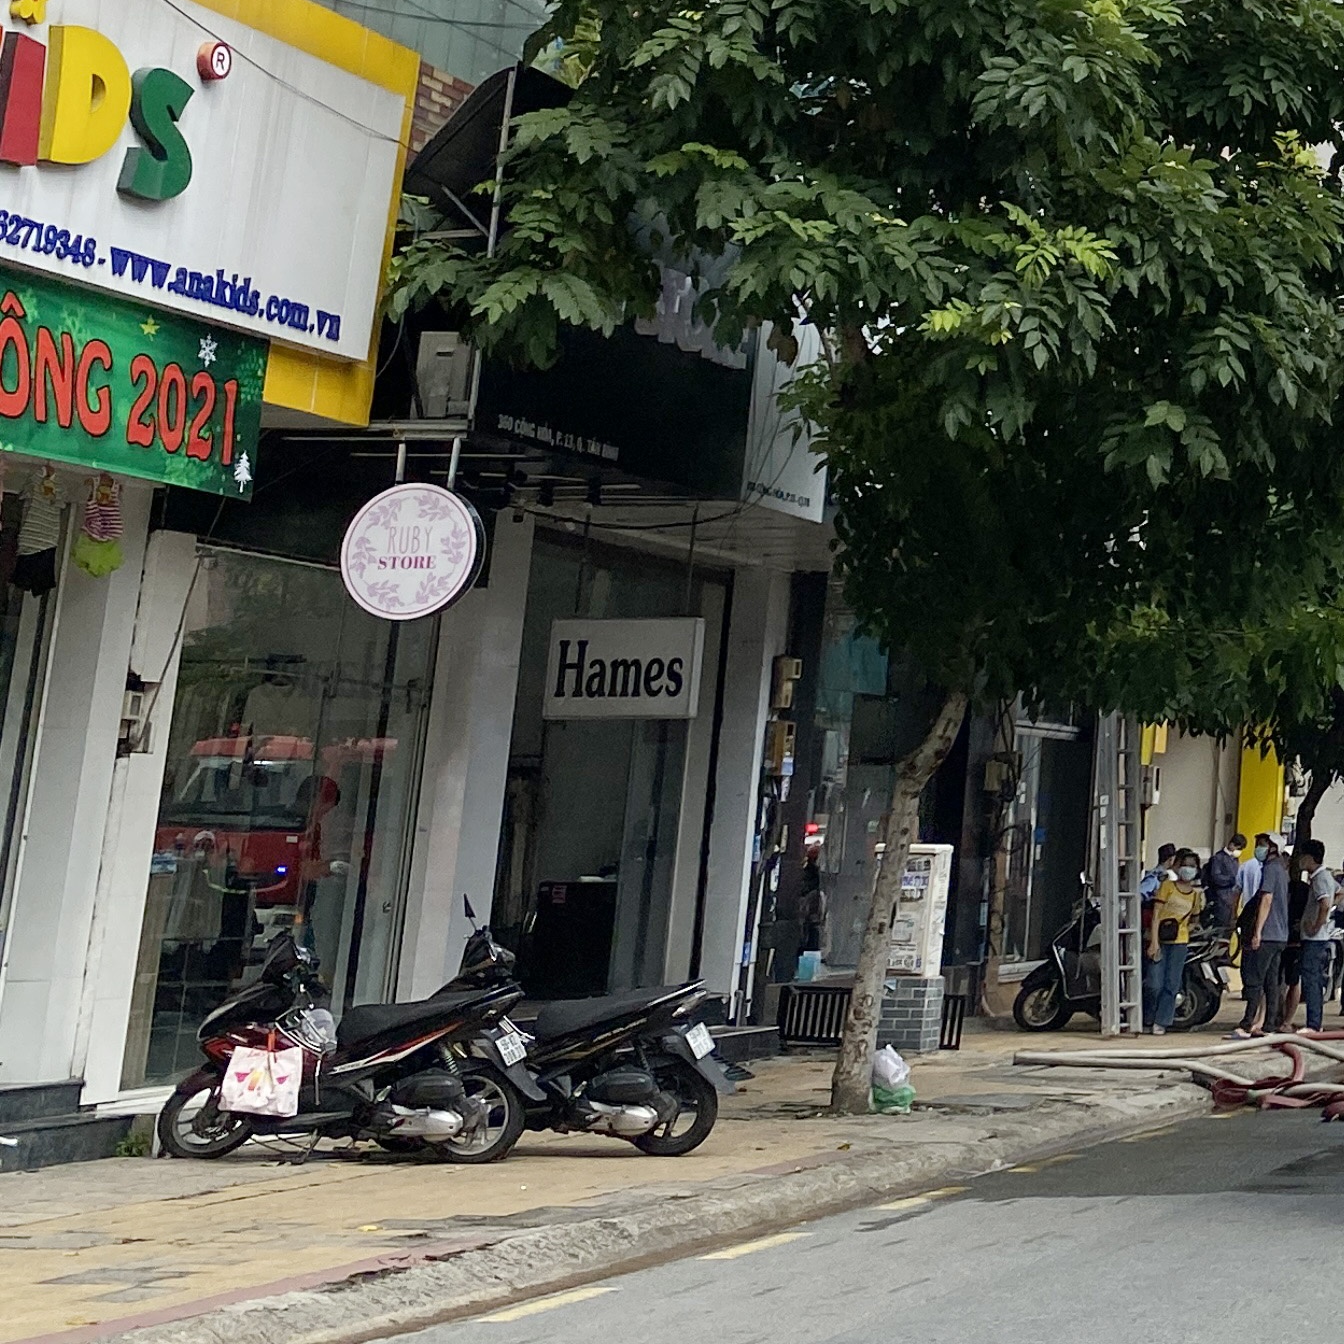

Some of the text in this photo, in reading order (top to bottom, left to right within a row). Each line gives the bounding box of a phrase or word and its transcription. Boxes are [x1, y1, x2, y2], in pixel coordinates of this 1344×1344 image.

[110, 246, 341, 342] www.anakids.com.vn
[127, 354, 239, 465] 2021
[377, 555, 437, 570] STORE
[387, 525, 434, 554] RUBY
[554, 638, 684, 699] Hames
